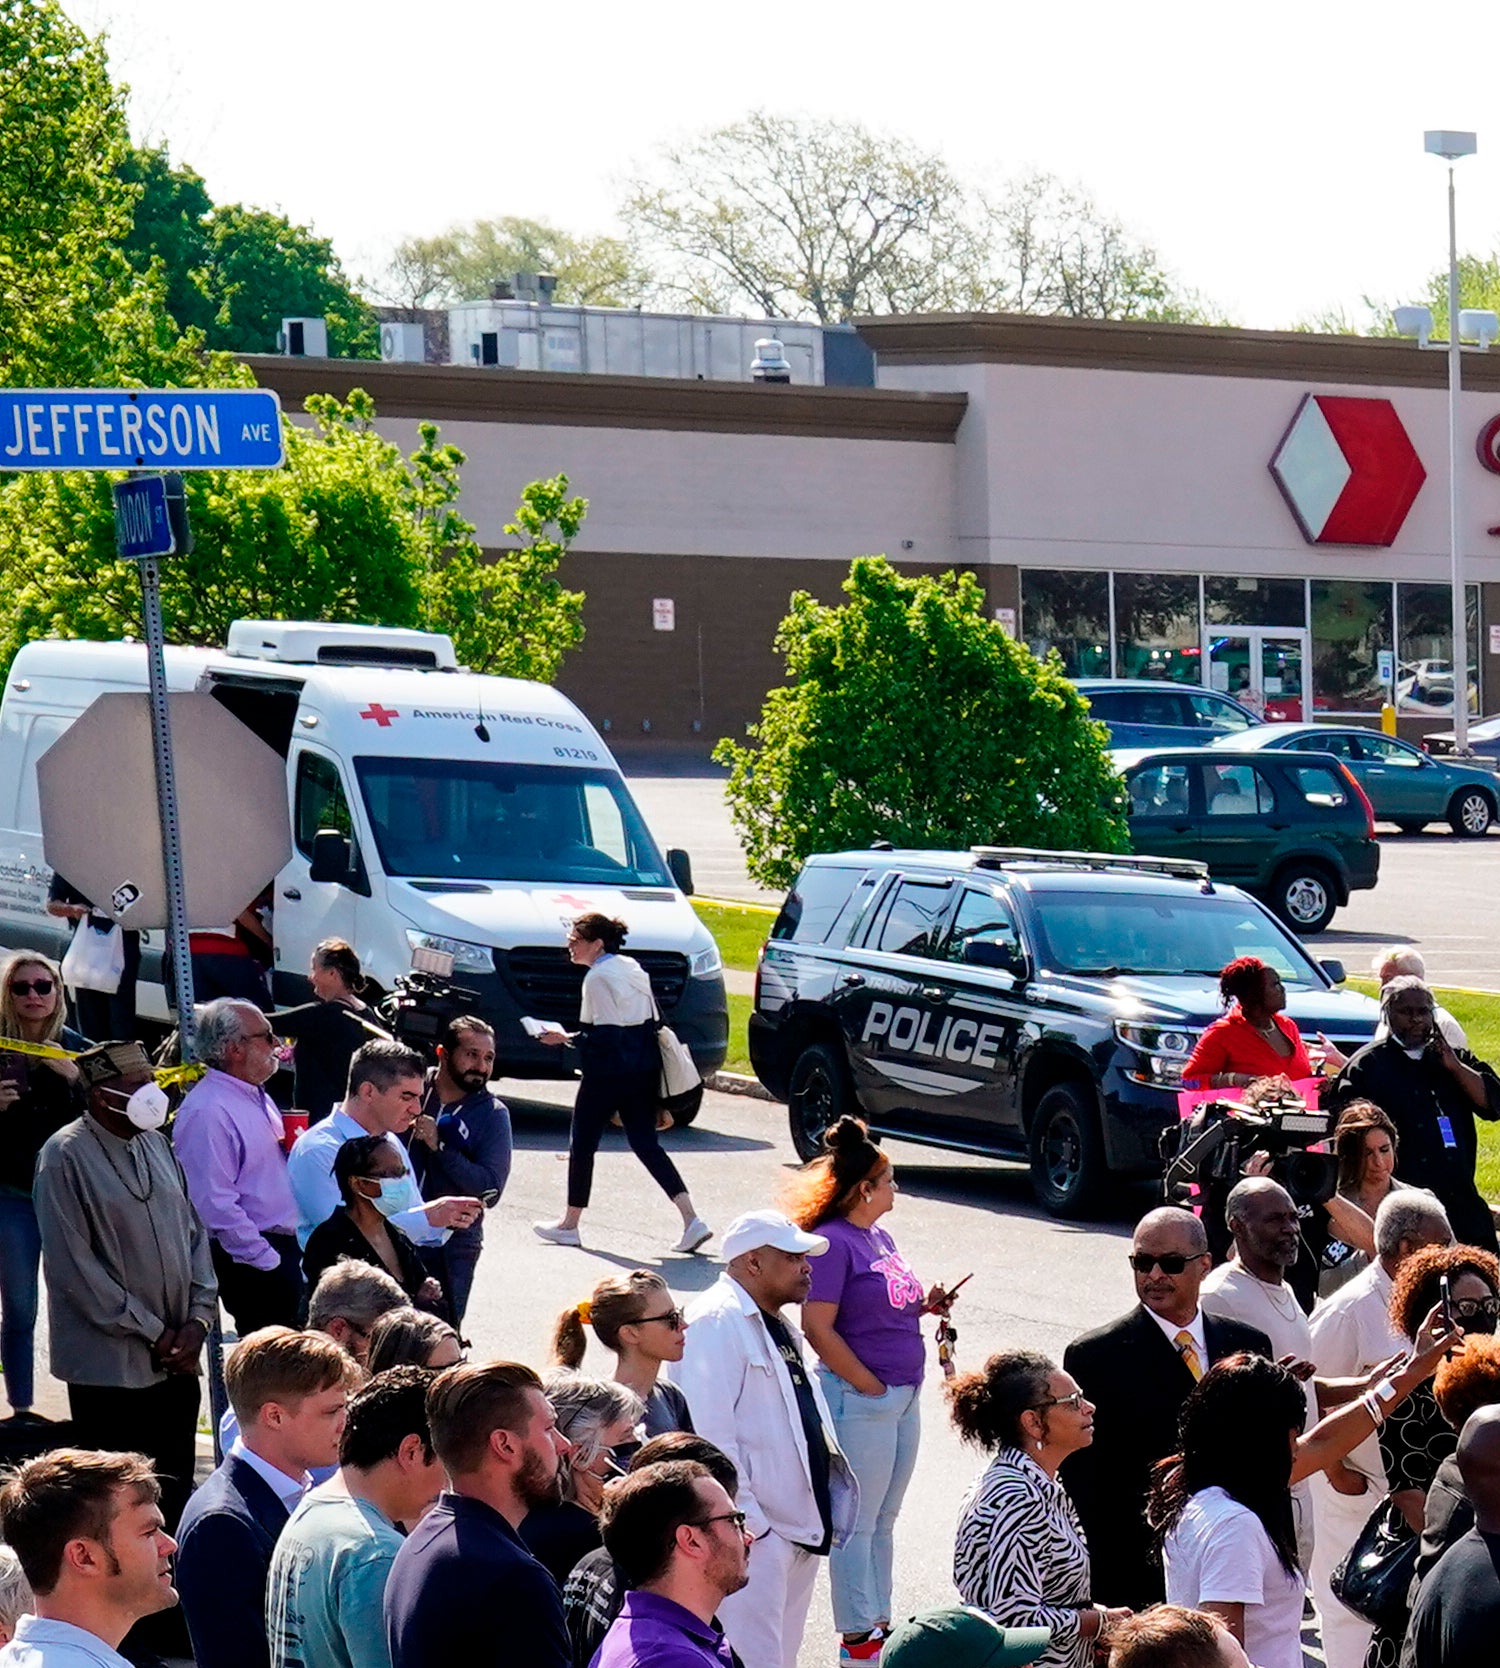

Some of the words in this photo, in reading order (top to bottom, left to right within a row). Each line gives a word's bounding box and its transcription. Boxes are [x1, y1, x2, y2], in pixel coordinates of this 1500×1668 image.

[6, 404, 221, 456] JEFFERSON
[241, 423, 271, 442] AVE
[413, 708, 496, 722] American
[500, 713, 532, 725] Red
[535, 716, 582, 733] Cross
[553, 746, 598, 762] 81219
[866, 974, 919, 997] TRANSIT
[861, 1000, 1005, 1070] POLICE
